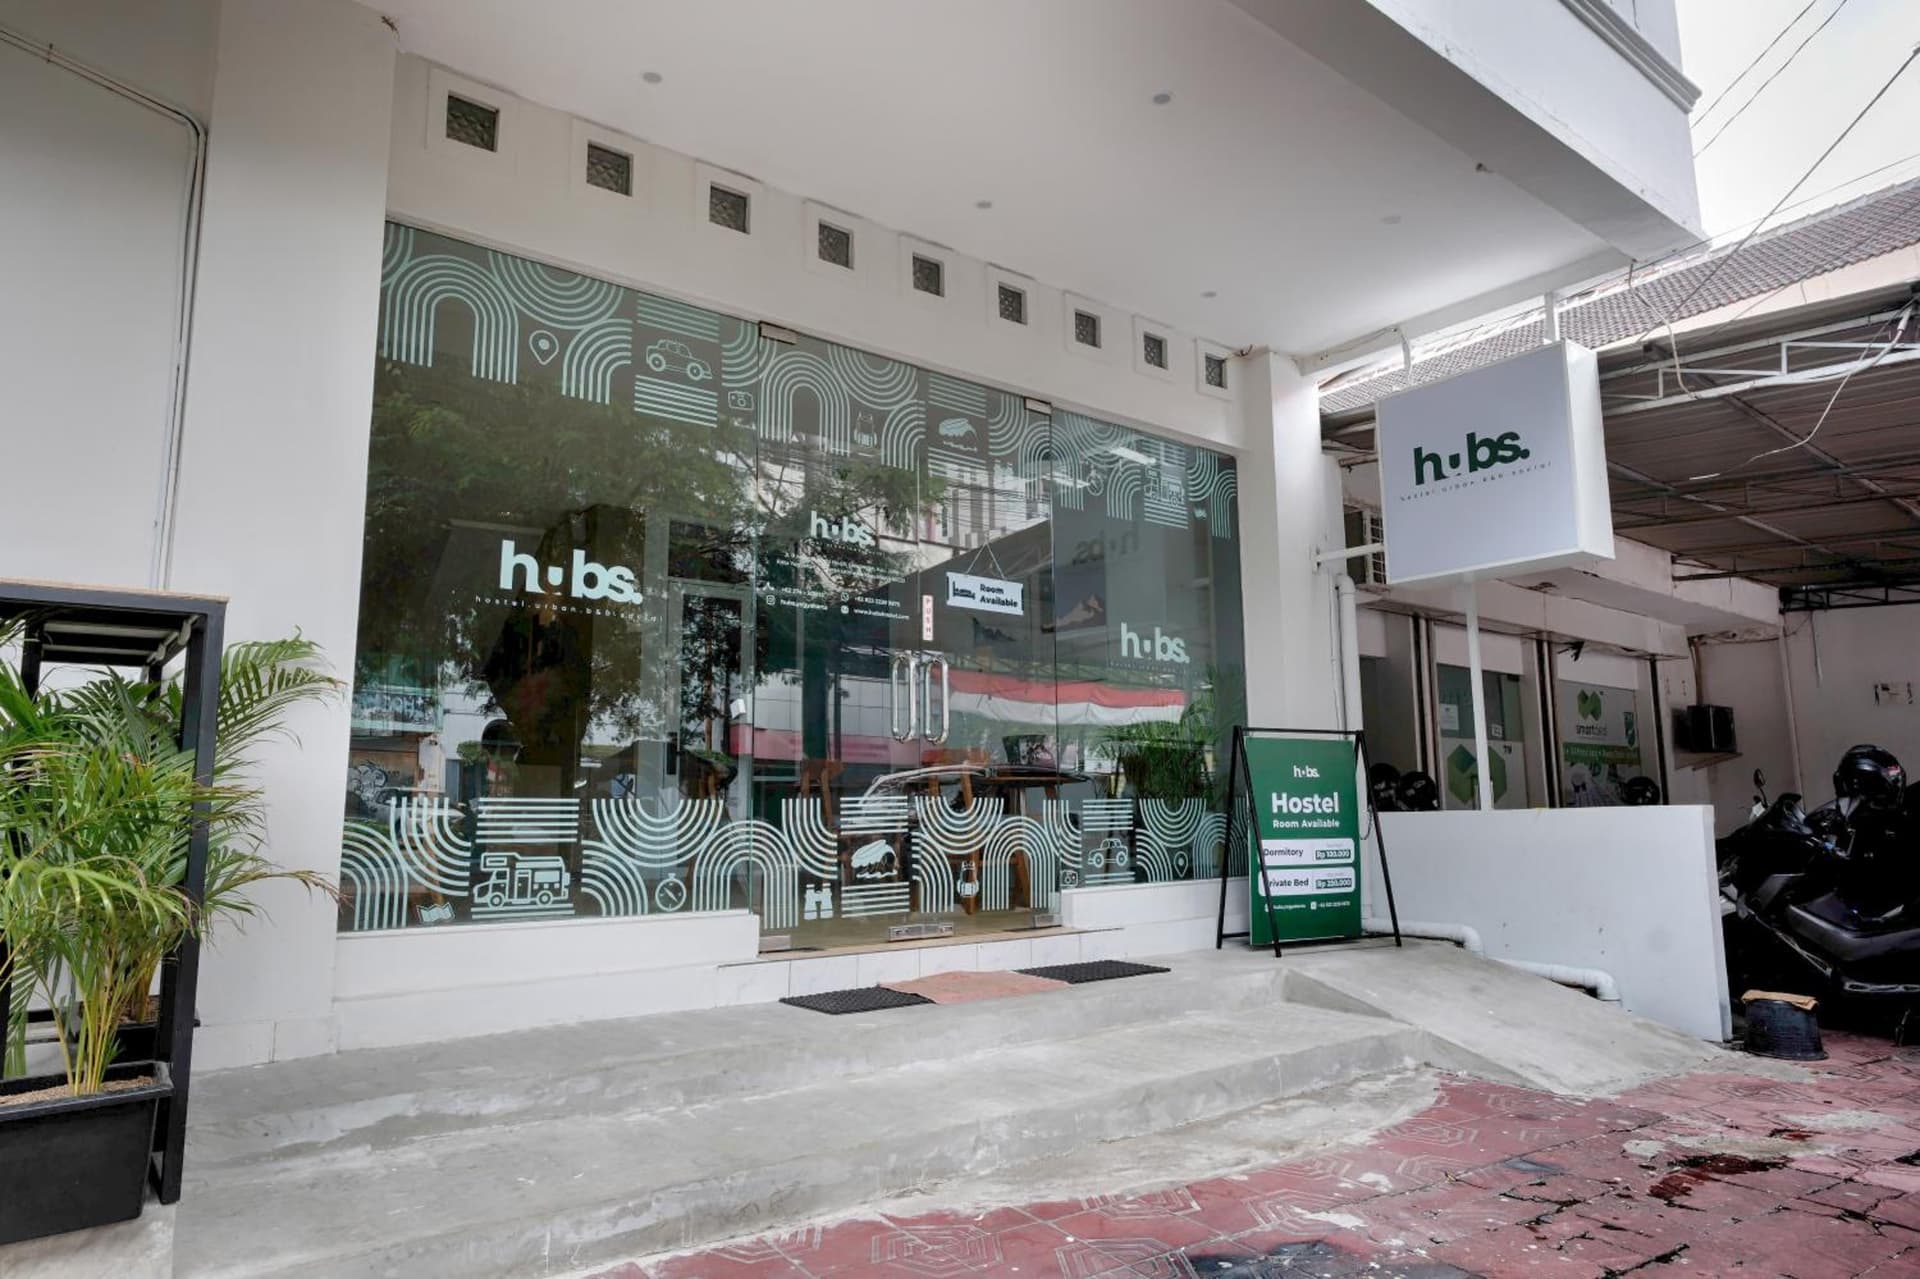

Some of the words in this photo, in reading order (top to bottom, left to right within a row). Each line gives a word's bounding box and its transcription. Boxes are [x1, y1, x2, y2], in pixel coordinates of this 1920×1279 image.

[980, 584, 1004, 594] Room
[980, 595, 1018, 608] Available
[1271, 792, 1339, 813] Hostel
[1273, 819, 1299, 829] Room
[1301, 818, 1340, 828] Available
[1263, 848, 1304, 858] Dormitory
[1293, 878, 1309, 887] Bed
